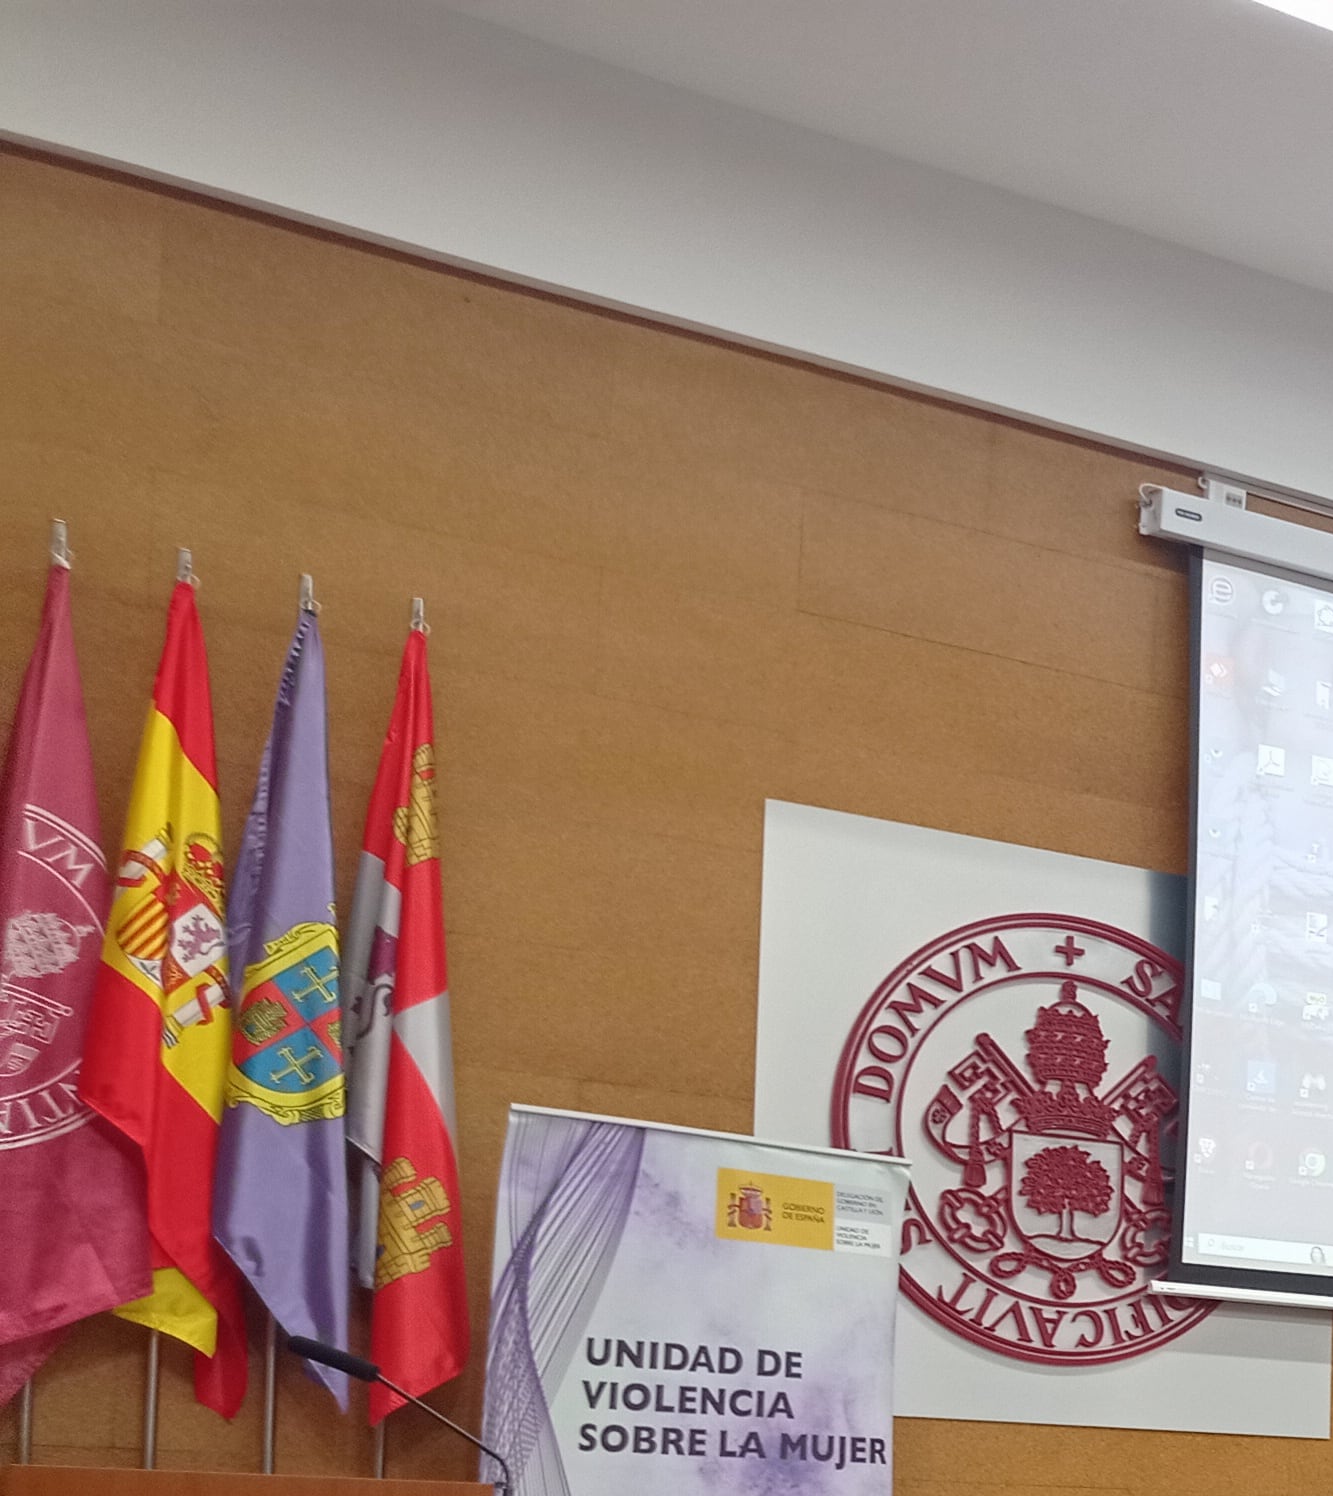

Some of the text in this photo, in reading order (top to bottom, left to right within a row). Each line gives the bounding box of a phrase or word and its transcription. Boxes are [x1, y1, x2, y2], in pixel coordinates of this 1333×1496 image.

[853, 936, 1021, 1104] DOMVM
[783, 1202, 825, 1215] GOBIERNO
[796, 1213, 825, 1224] ESPAÑA
[586, 1337, 803, 1379] UNIDAD DE
[582, 1379, 795, 1420] VIOLENCIA
[578, 1422, 887, 1470] SOBRE LA MUJER
